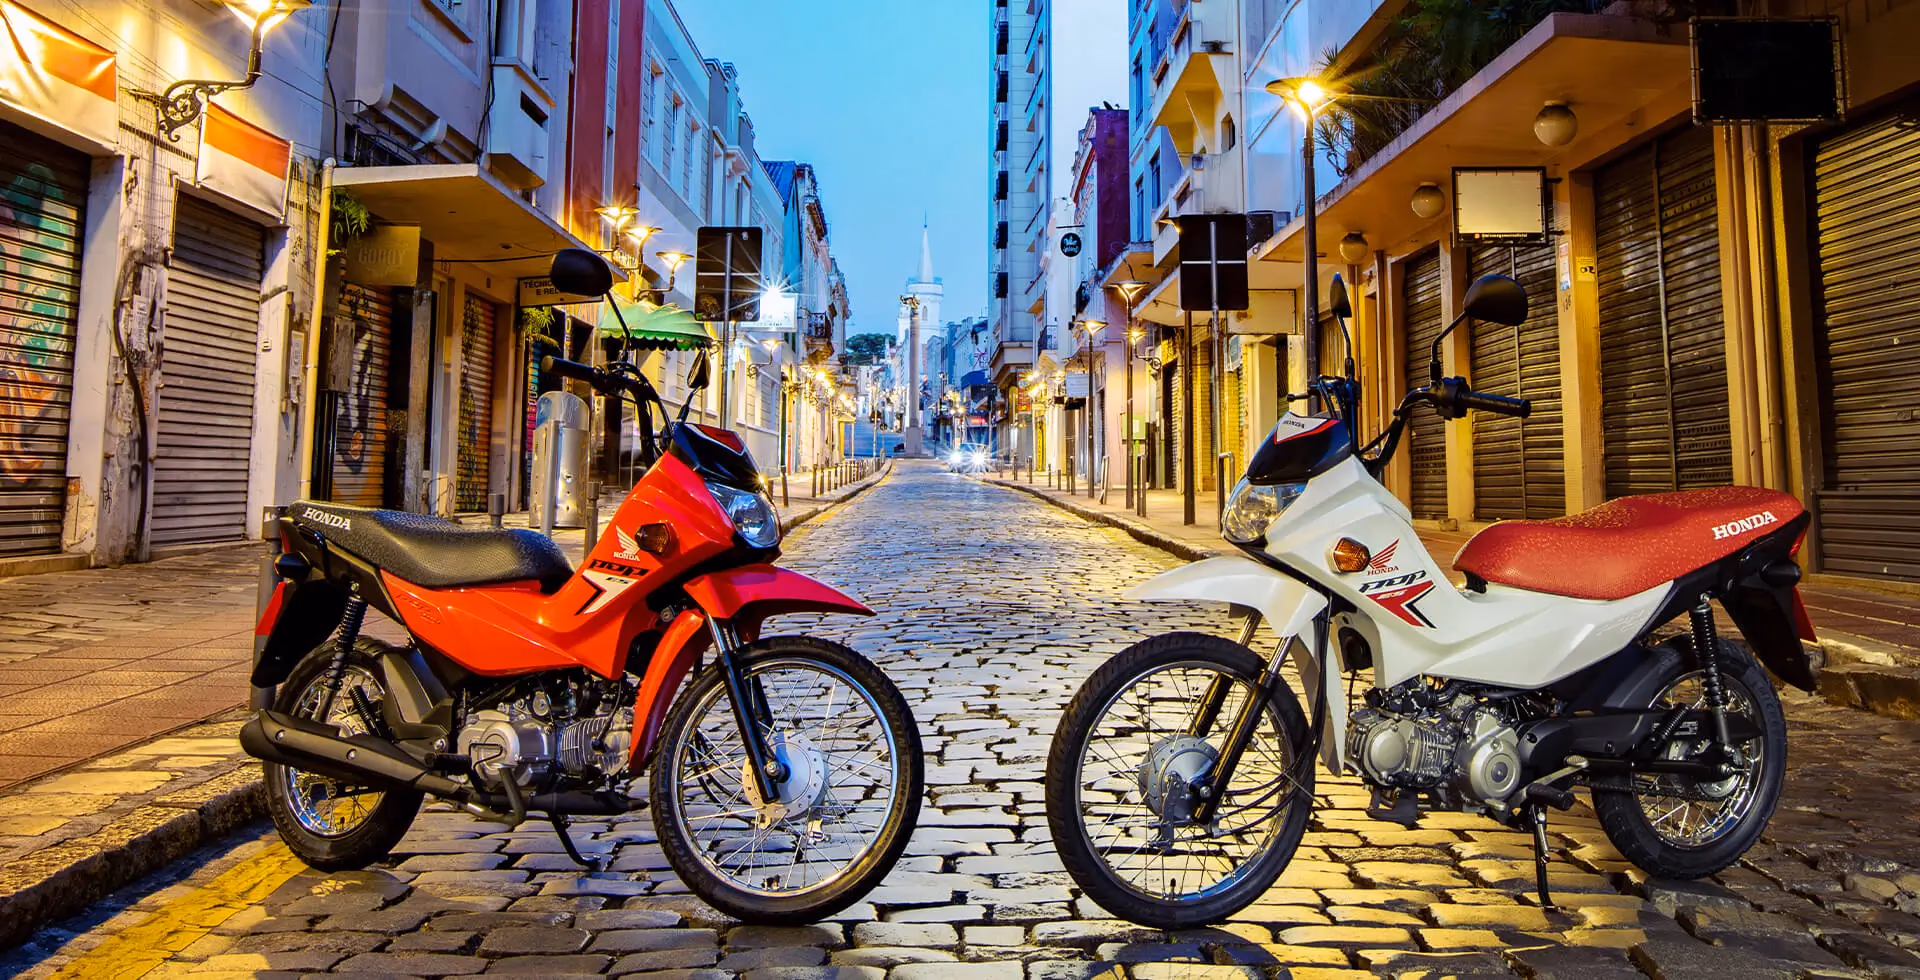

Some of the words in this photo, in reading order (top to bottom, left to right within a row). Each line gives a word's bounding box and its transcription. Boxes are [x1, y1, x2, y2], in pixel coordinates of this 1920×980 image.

[302, 507, 351, 530] HONDA
[1712, 511, 1778, 540] HONDA
[613, 551, 640, 562] HONDA
[1367, 566, 1399, 576] HONDA
